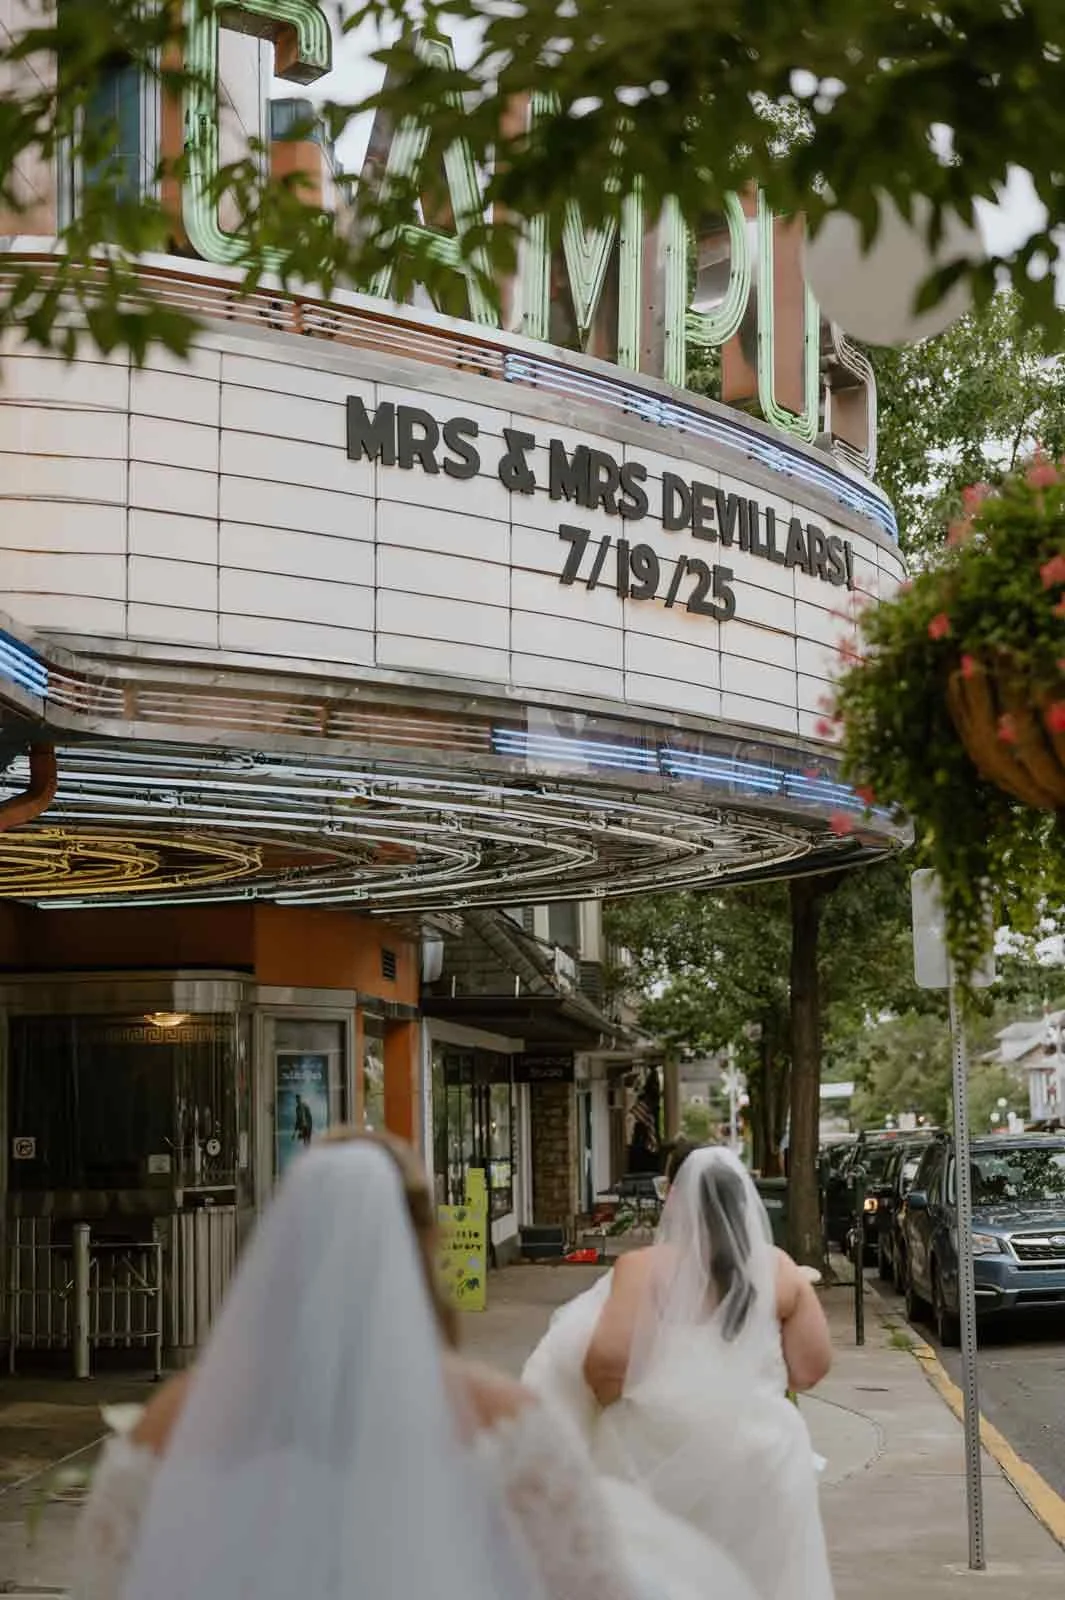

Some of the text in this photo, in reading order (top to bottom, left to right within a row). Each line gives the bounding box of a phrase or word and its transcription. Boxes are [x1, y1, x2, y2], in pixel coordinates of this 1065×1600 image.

[346, 395, 480, 480] MRS
[498, 428, 536, 494] &
[549, 439, 649, 521] MRS
